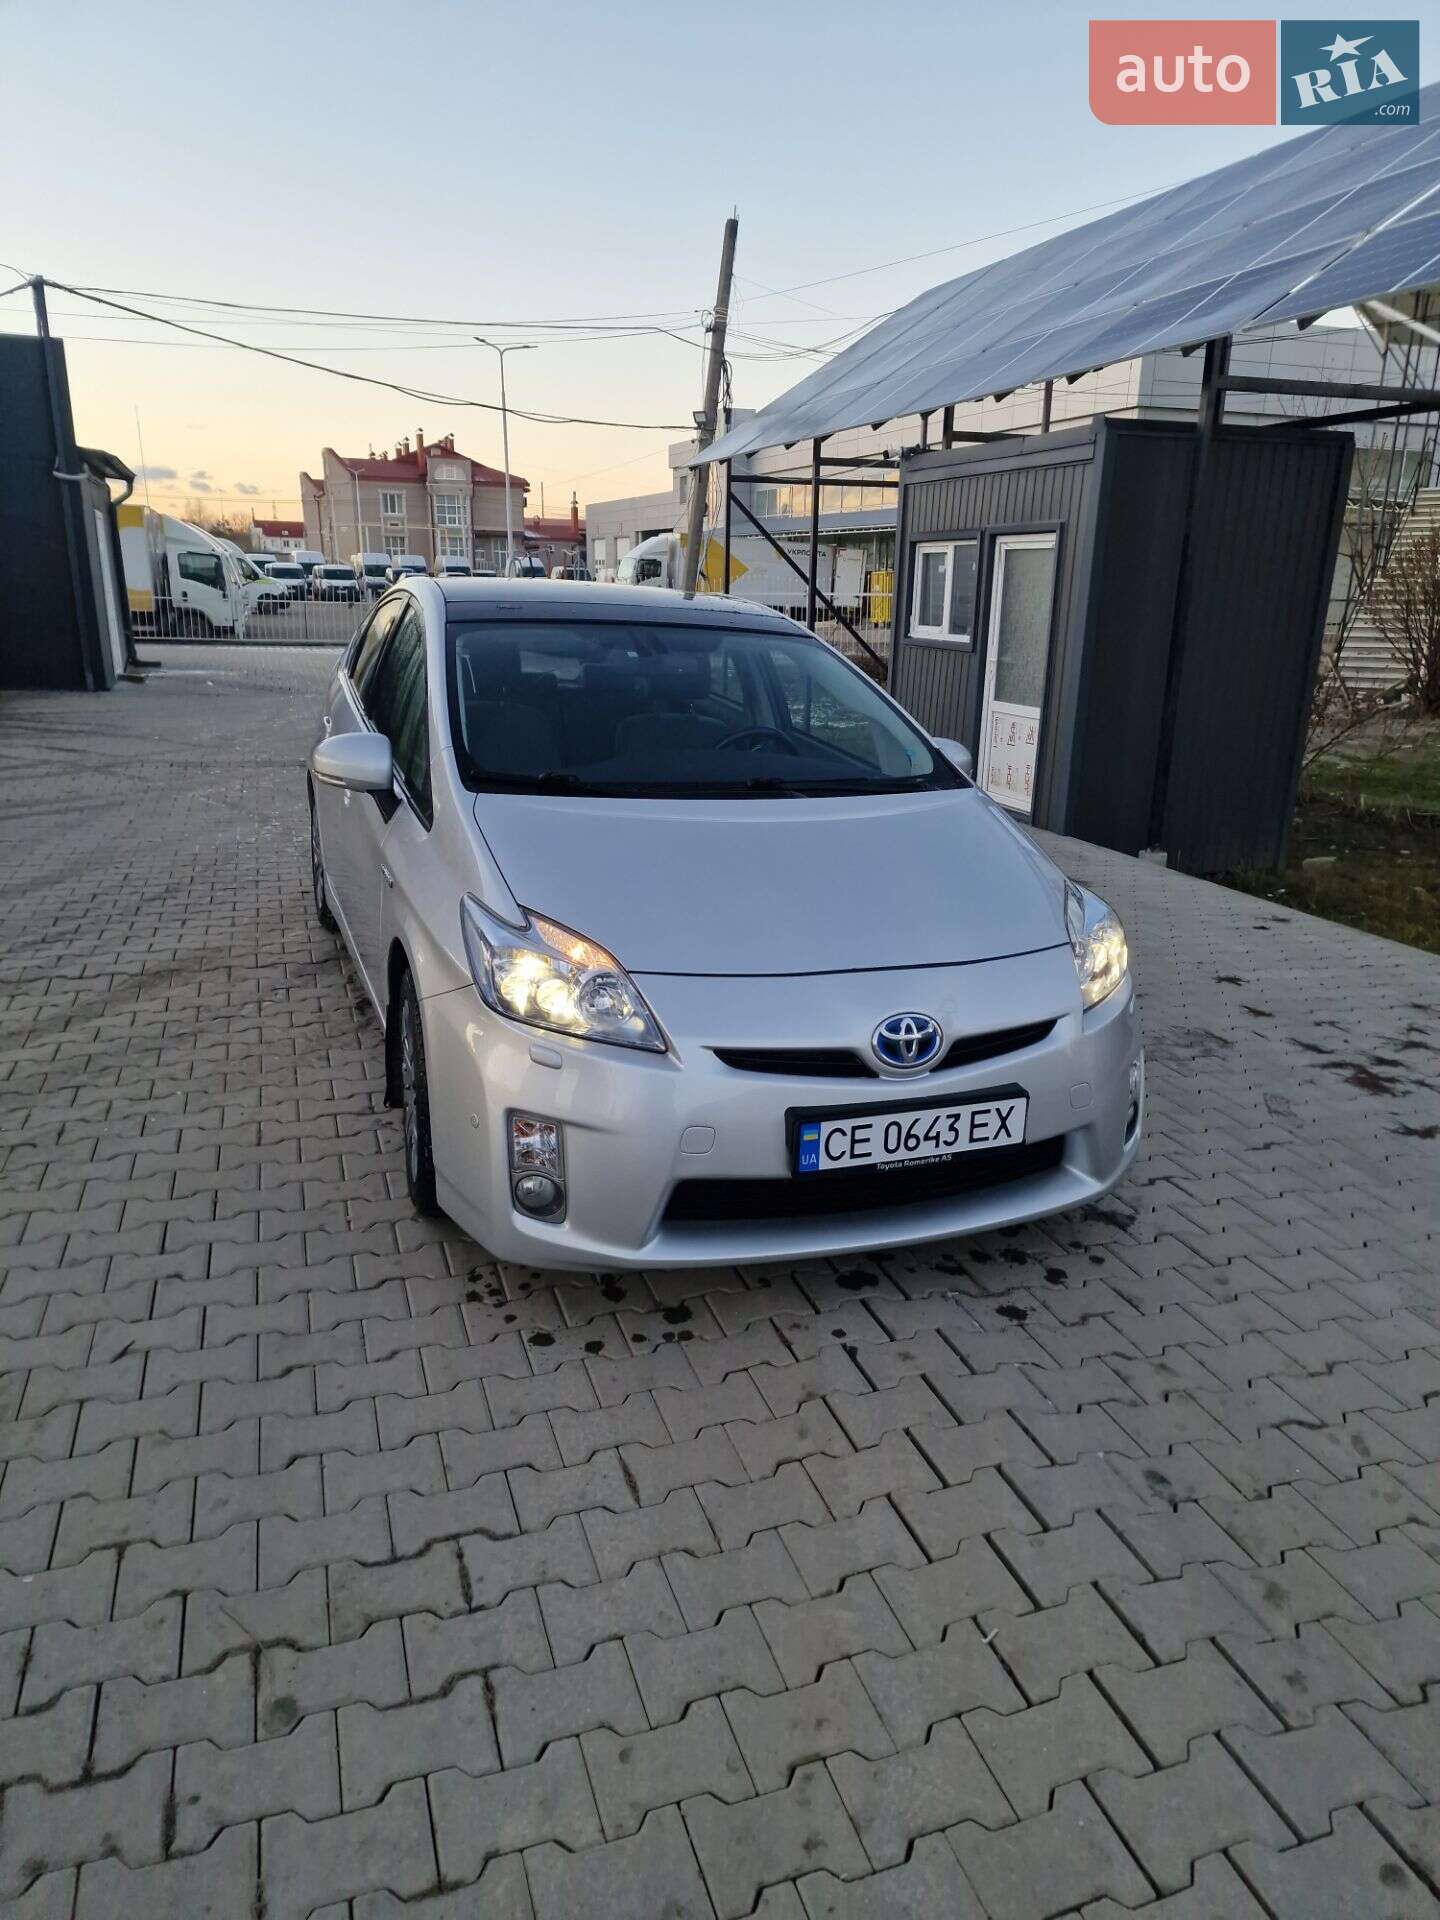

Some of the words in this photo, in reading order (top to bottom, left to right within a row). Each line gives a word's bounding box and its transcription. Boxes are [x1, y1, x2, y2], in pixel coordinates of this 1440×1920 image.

[787, 549, 826, 557] УКРПОТА
[824, 1123, 873, 1162] CE
[883, 1113, 961, 1155] 0643
[968, 1105, 1015, 1144] EX
[801, 1155, 818, 1166] UA
[876, 1162, 903, 1171] Toyota
[941, 1153, 952, 1161] AS
